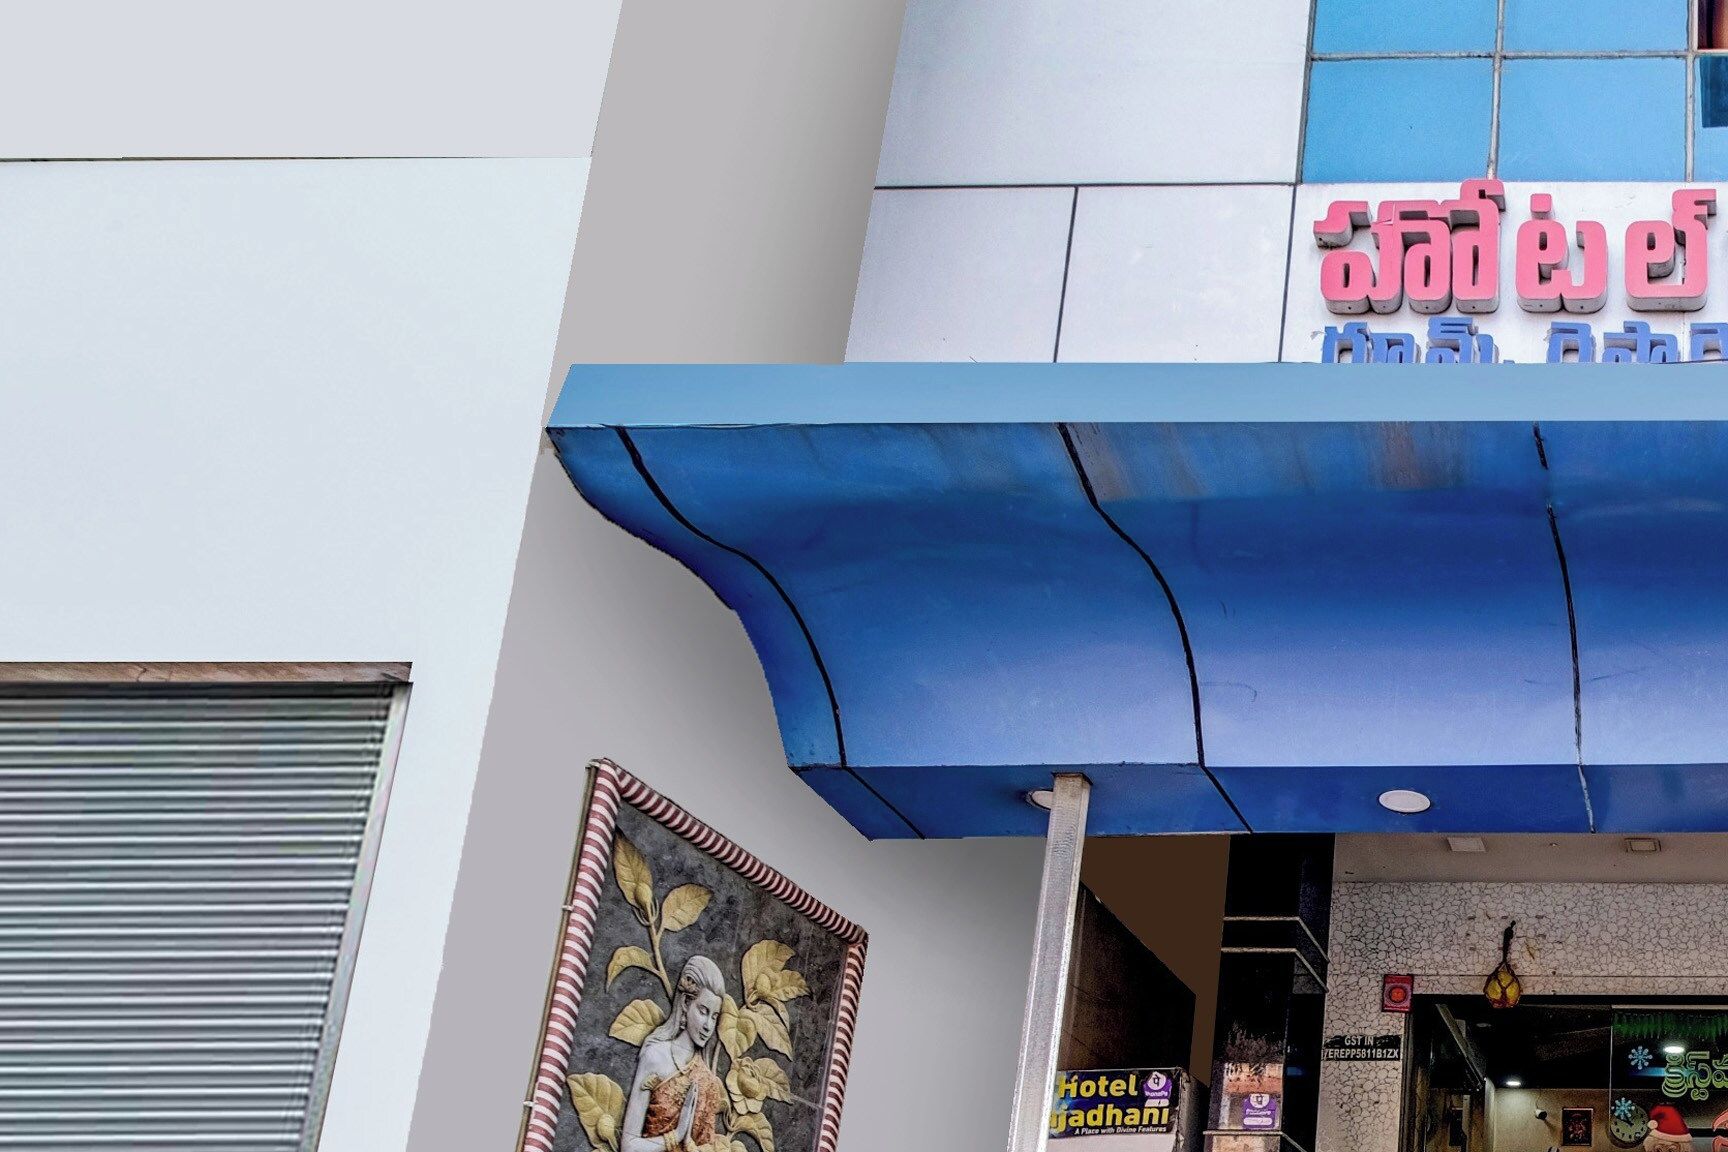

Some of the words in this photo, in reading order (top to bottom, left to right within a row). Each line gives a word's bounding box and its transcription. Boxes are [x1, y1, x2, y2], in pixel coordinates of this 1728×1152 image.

[1313, 179, 1717, 312] హోటల్
[1344, 1035, 1361, 1046] GST
[1364, 1035, 1374, 1046] IN
[1058, 1073, 1138, 1098] Hotel
[1081, 1127, 1099, 1135] Place
[1116, 1126, 1136, 1134] Divine
[1138, 1125, 1166, 1133] Features
